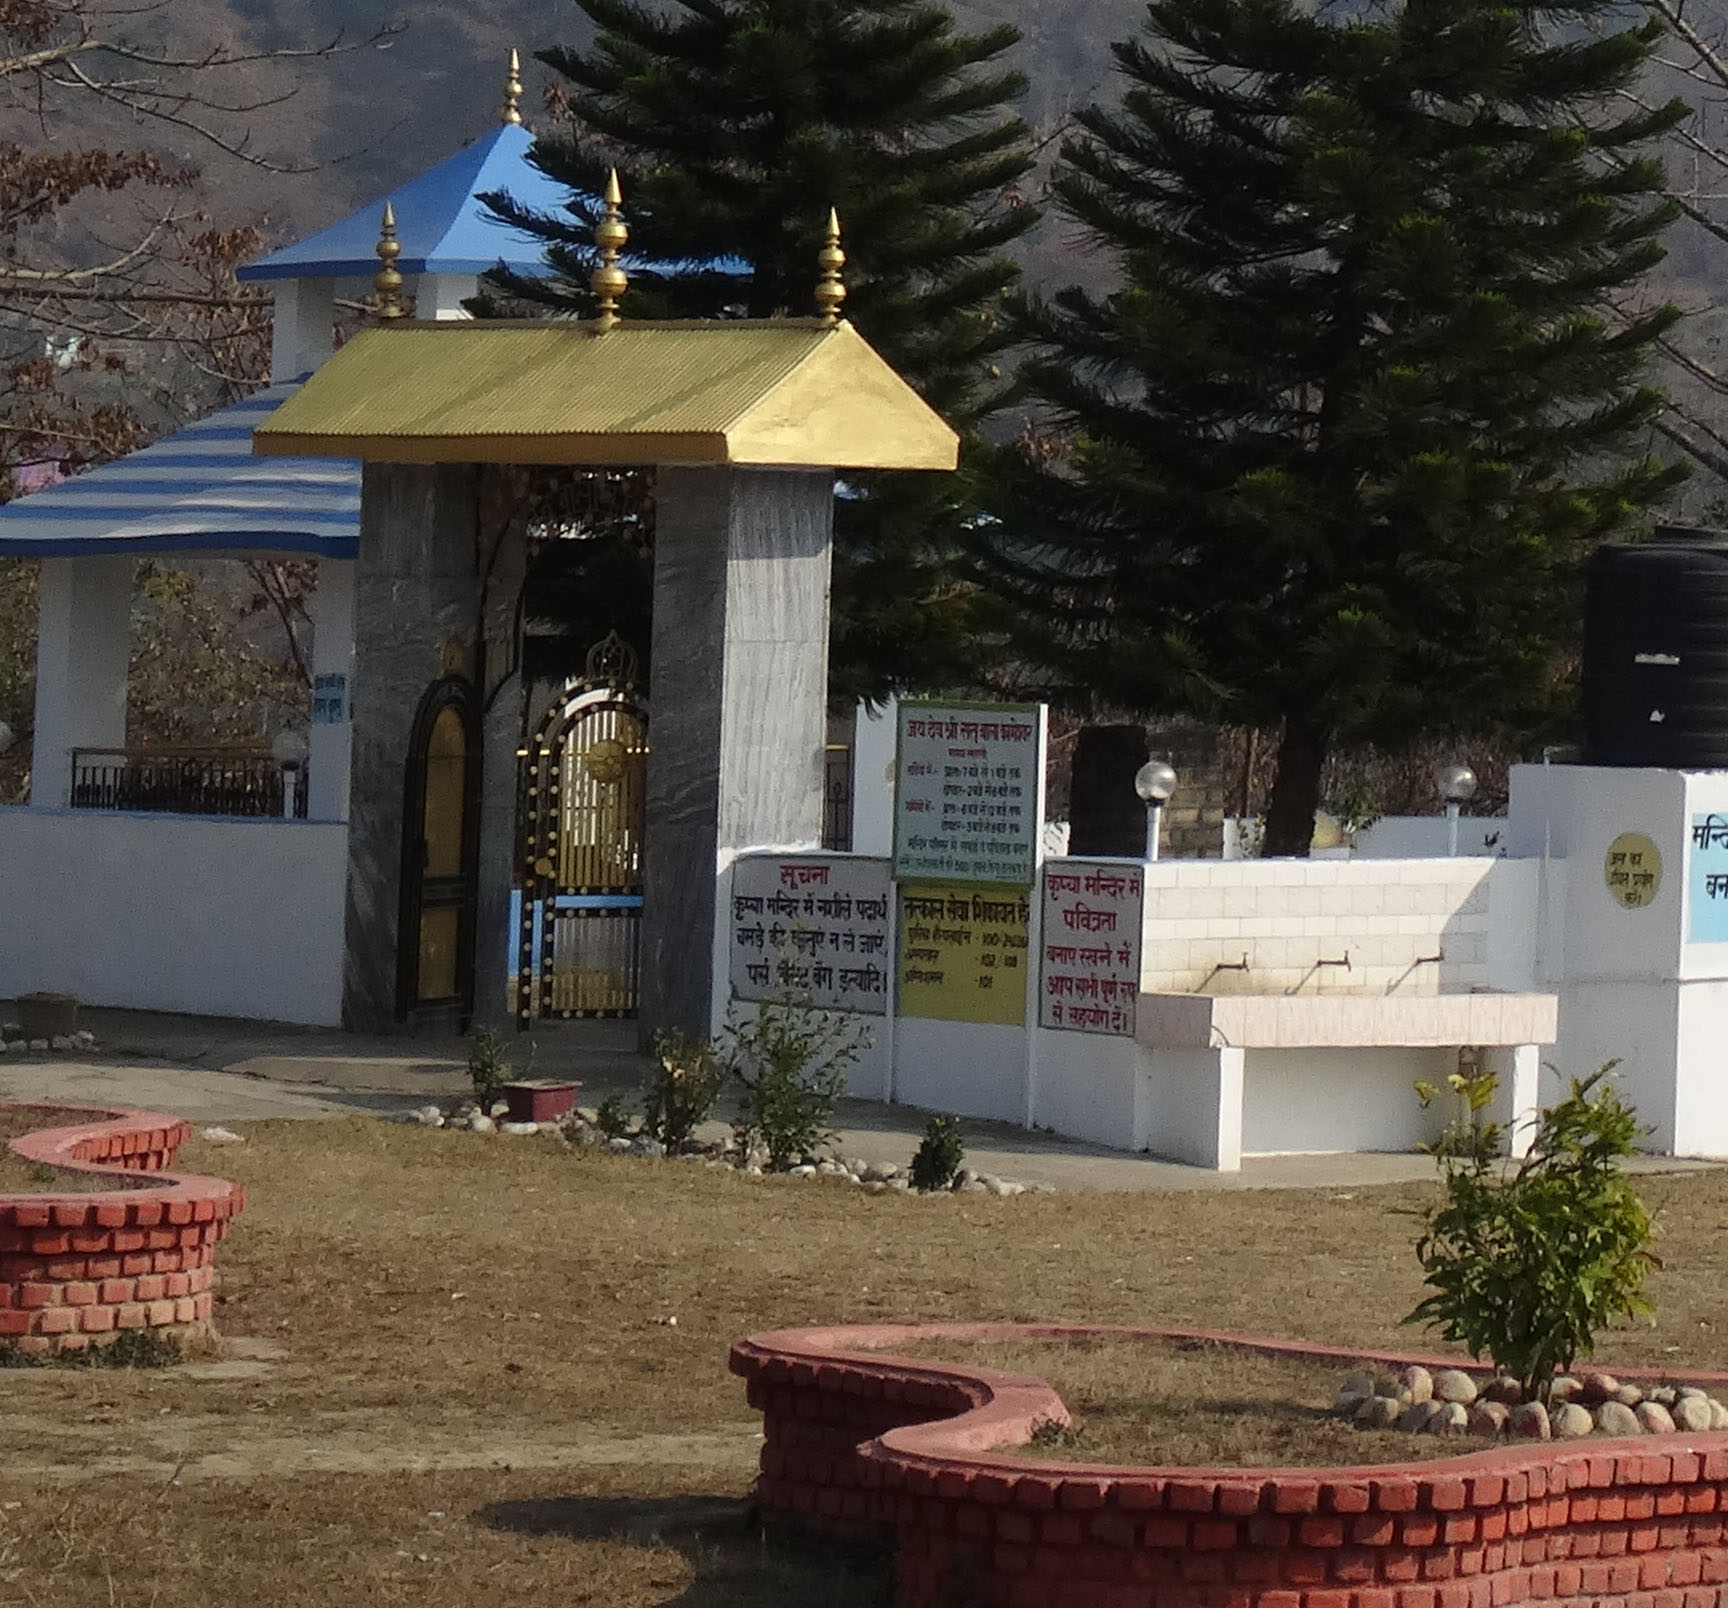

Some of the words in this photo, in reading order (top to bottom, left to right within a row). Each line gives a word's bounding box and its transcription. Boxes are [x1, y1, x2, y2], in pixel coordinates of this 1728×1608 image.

[779, 865, 830, 890] सूचना
[1084, 869, 1126, 900] मन्दिर
[1129, 872, 1141, 897] में
[803, 892, 815, 915] में
[1063, 903, 1117, 932] पवित्रता
[830, 933, 839, 951] न
[1117, 940, 1132, 968] में
[1068, 1003, 1109, 1029] सहयोग
